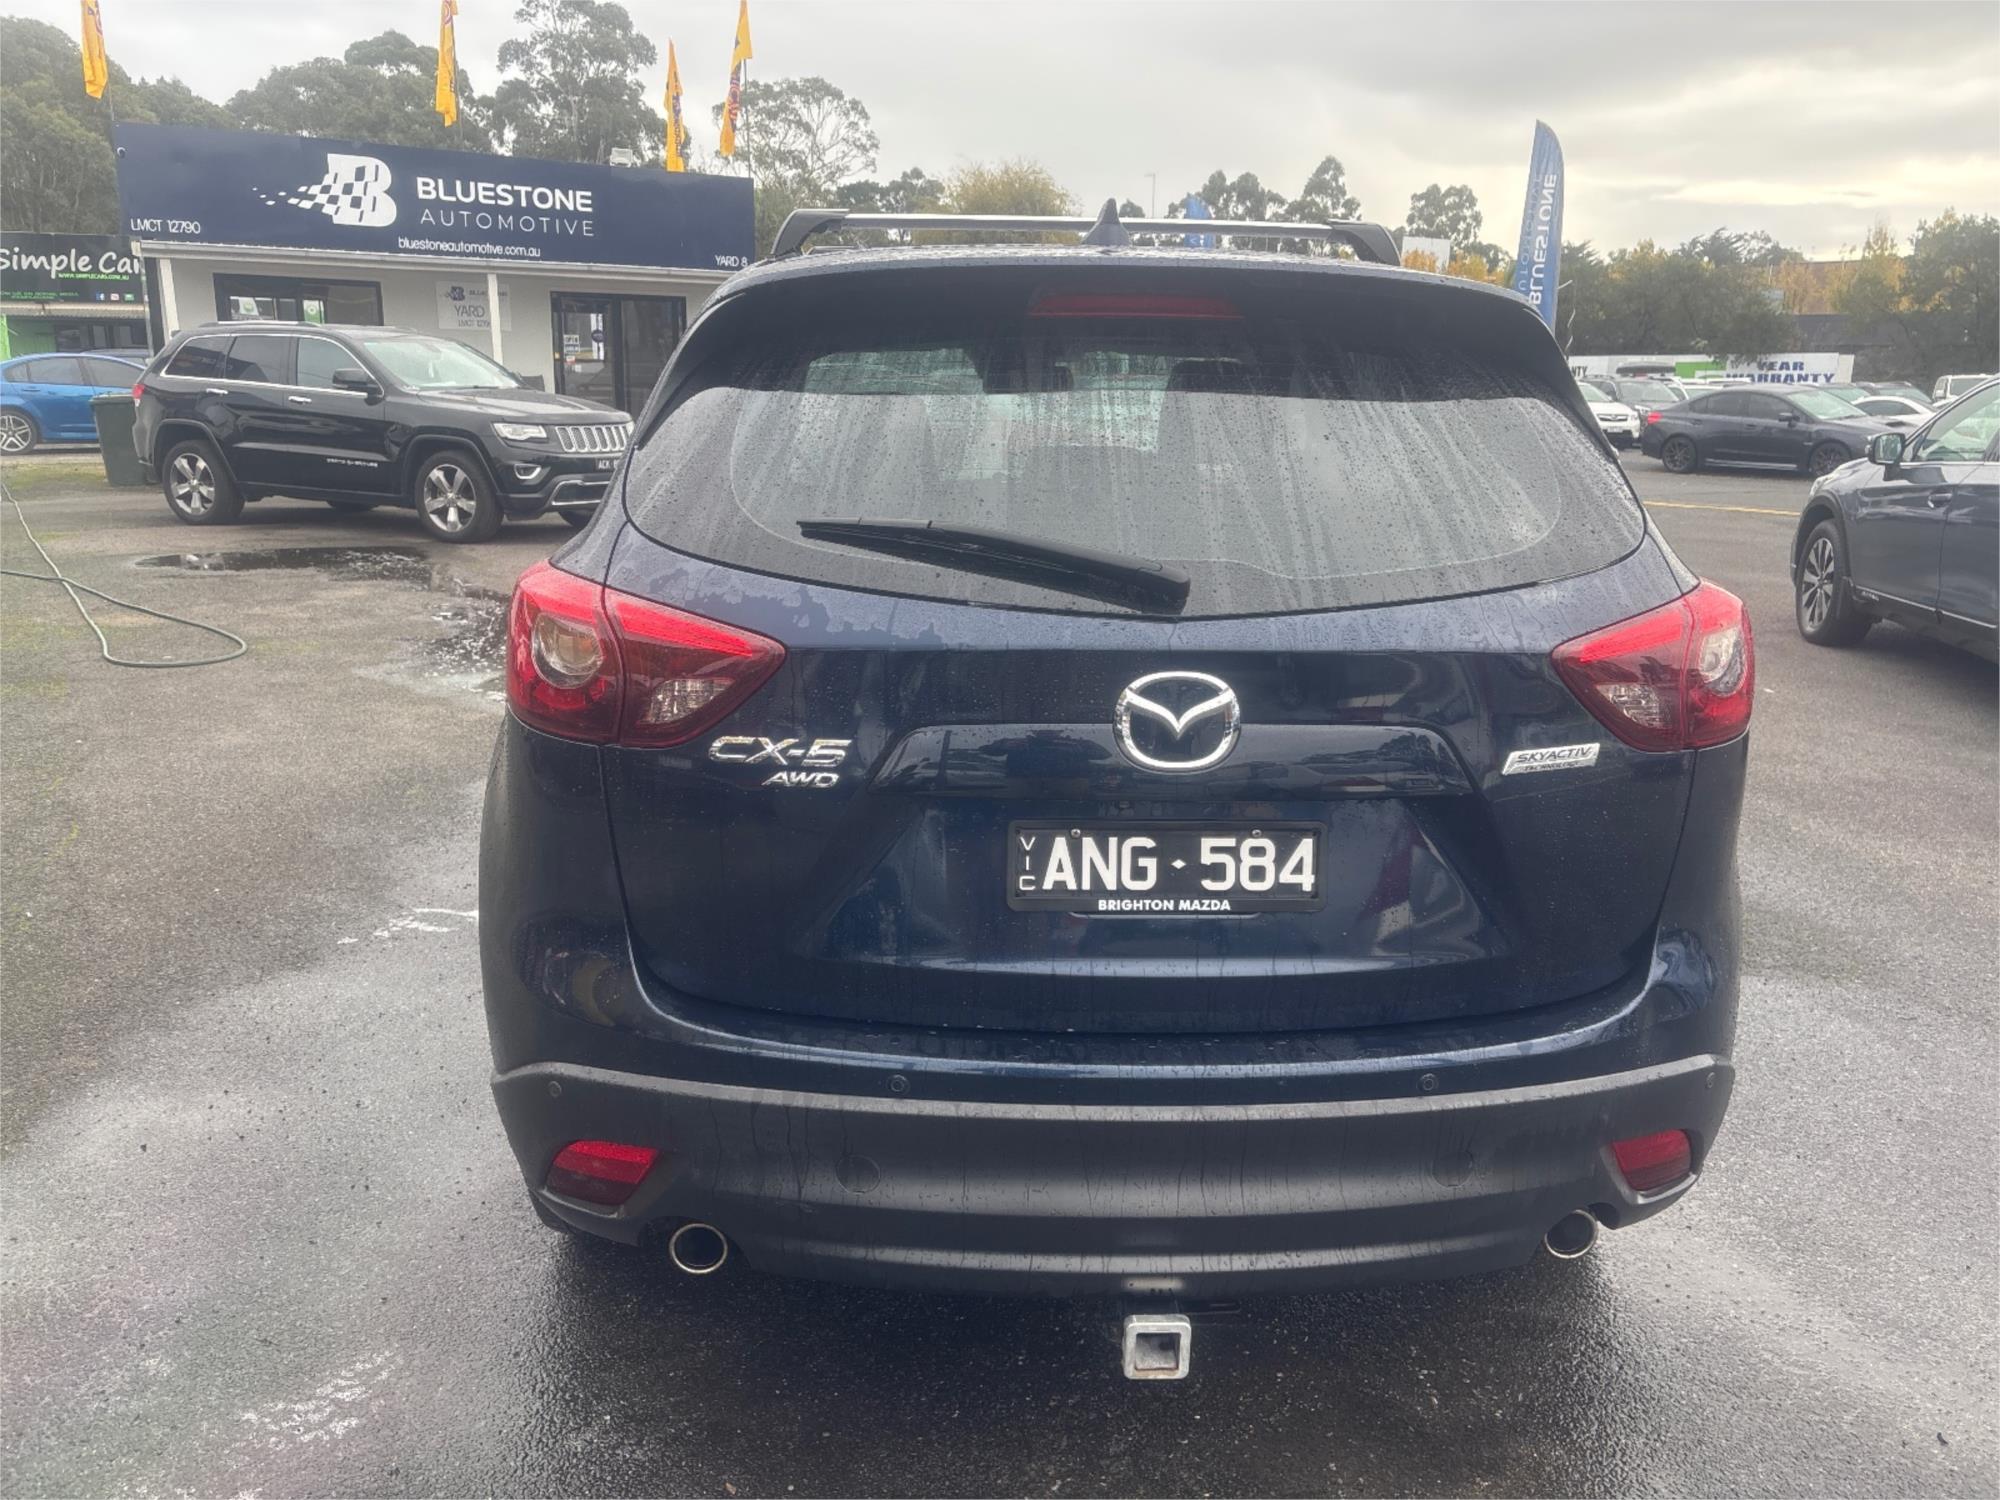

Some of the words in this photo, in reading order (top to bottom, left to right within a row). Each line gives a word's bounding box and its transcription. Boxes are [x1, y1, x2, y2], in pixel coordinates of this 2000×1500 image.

[416, 176, 593, 212] BLUESTONE
[130, 218, 162, 232] LMCT
[167, 219, 201, 234] 12790
[420, 208, 594, 236] AUTOMOTIVE
[398, 236, 541, 257] bluestoneautomotive.com.au
[0, 246, 92, 279] Simple
[714, 254, 740, 267] YARD
[740, 256, 748, 267] 8
[454, 304, 485, 318] YARD
[708, 735, 852, 767] CX-5
[1516, 746, 1592, 763] SKYACTIV
[760, 770, 840, 788] AWD
[1019, 836, 1036, 891] VIC
[1042, 836, 1157, 891] ANG
[1200, 837, 1316, 892] 584
[1098, 899, 1174, 911] BRIGHTON
[1178, 899, 1231, 911] MAZDA
